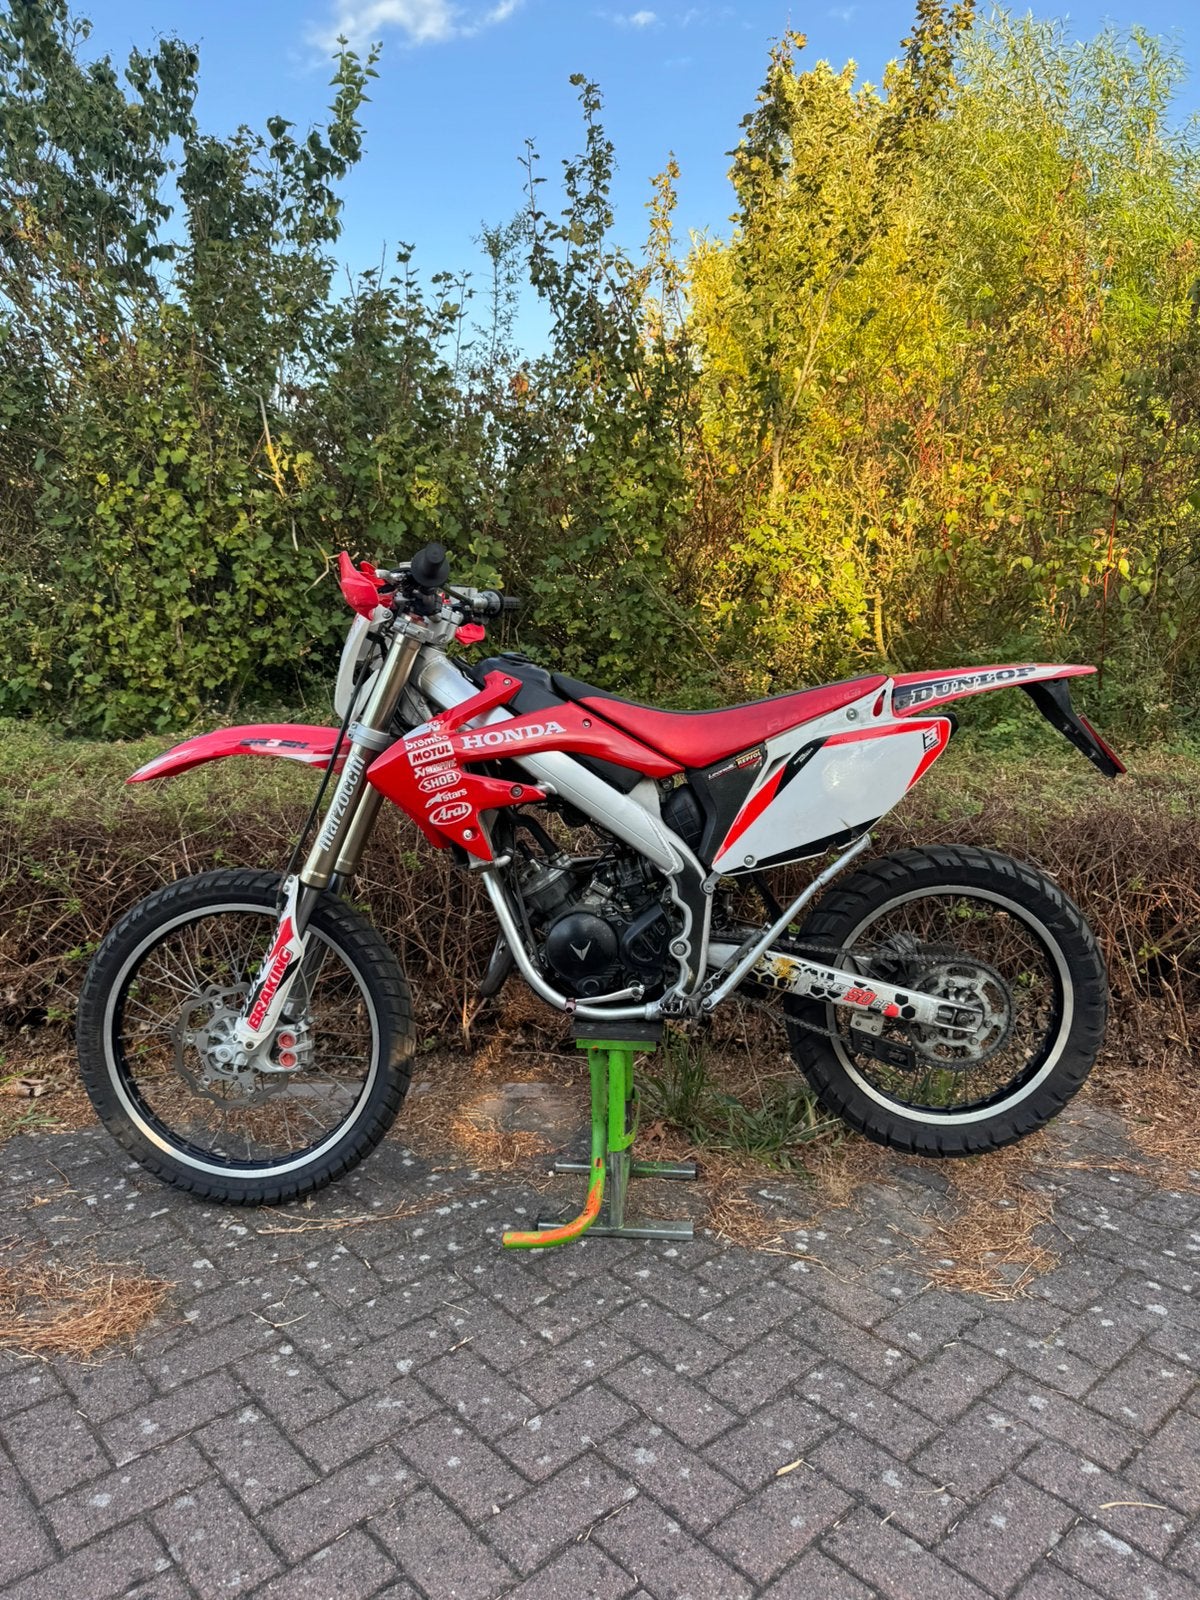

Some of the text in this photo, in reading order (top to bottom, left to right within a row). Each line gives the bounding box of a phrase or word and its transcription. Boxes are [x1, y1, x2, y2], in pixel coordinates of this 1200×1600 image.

[910, 666, 1036, 706] DUNLOP
[404, 733, 449, 751] brembo
[461, 721, 567, 750] HONDA
[412, 744, 452, 763] MOTUL
[423, 772, 458, 791] SHOEI
[318, 754, 366, 852] marzocchi
[433, 803, 468, 823] Arai
[247, 945, 294, 1032] BRAKING
[842, 986, 878, 1006] 50
